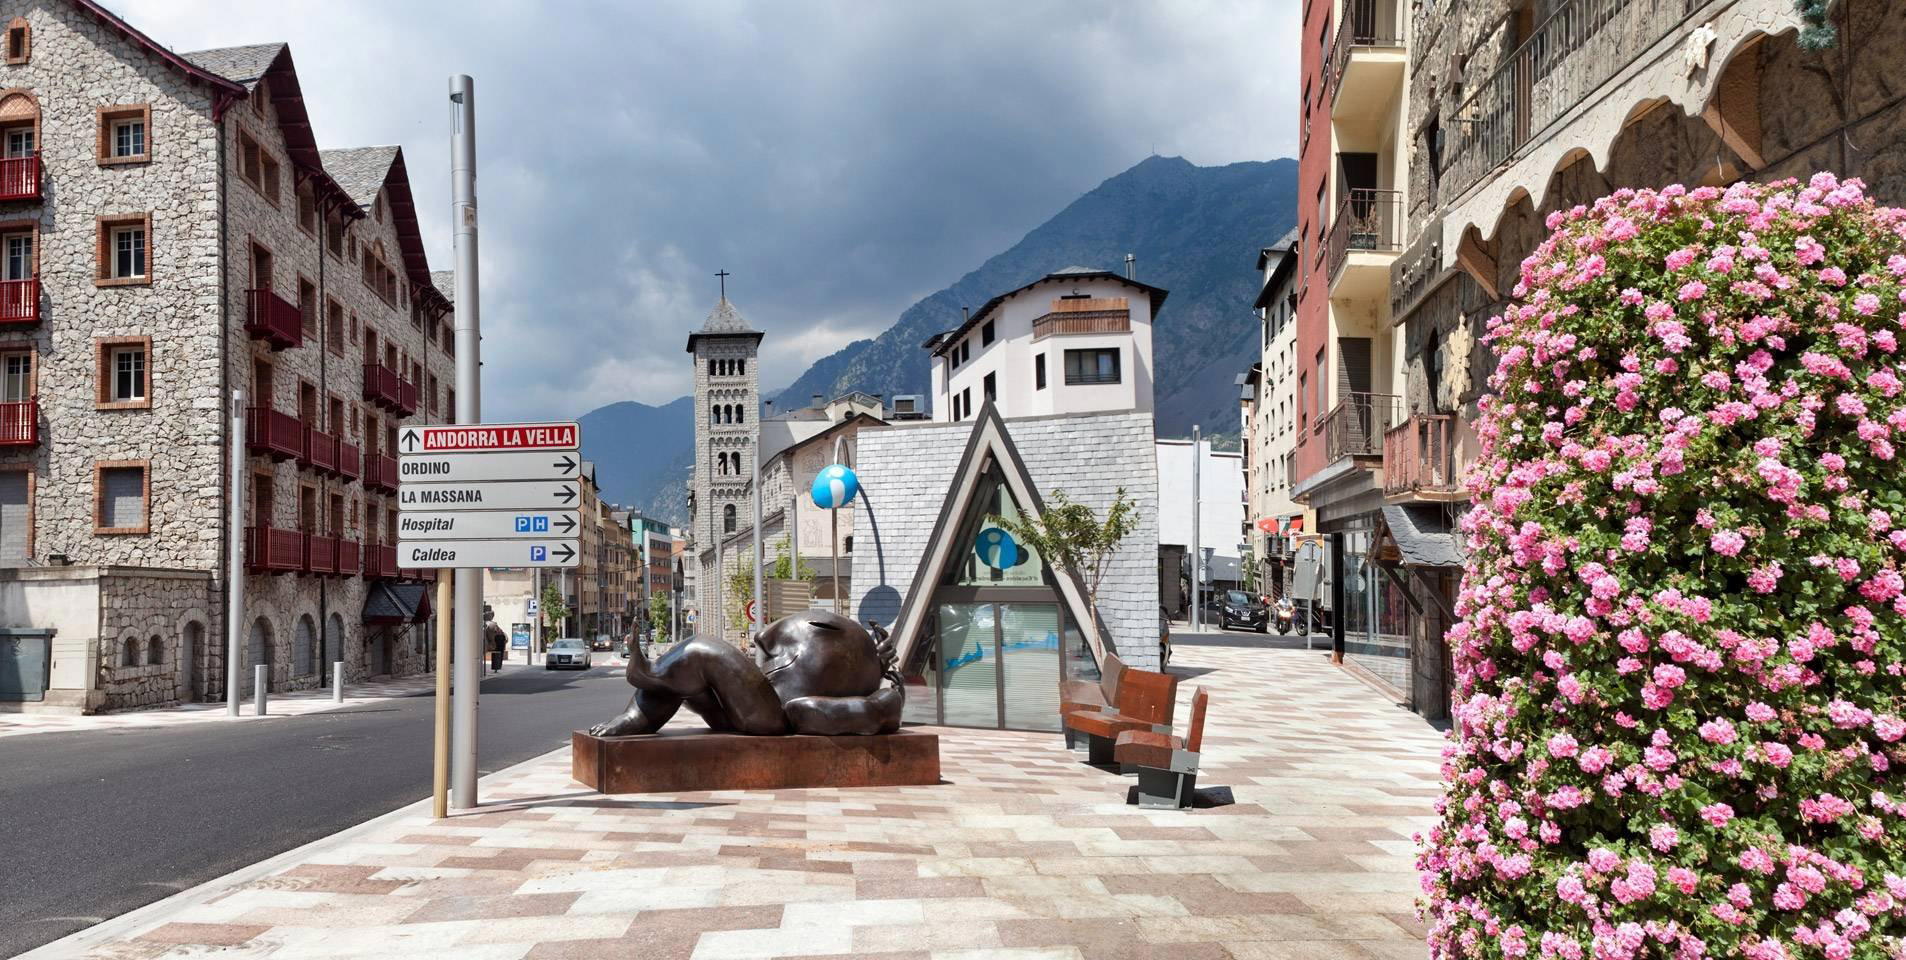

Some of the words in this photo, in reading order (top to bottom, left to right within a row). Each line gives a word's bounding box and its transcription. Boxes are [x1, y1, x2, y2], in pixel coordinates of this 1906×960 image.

[426, 430, 499, 448] ANDORRA
[503, 430, 522, 446] LA
[526, 428, 573, 445] VELLA
[402, 461, 450, 475] ORDINO
[401, 491, 417, 504] LA
[421, 490, 483, 503] MASSANA
[401, 517, 454, 533] Hospital
[518, 518, 528, 531] P
[536, 518, 545, 530] H
[412, 547, 456, 561] Caldea
[533, 547, 543, 560] P
